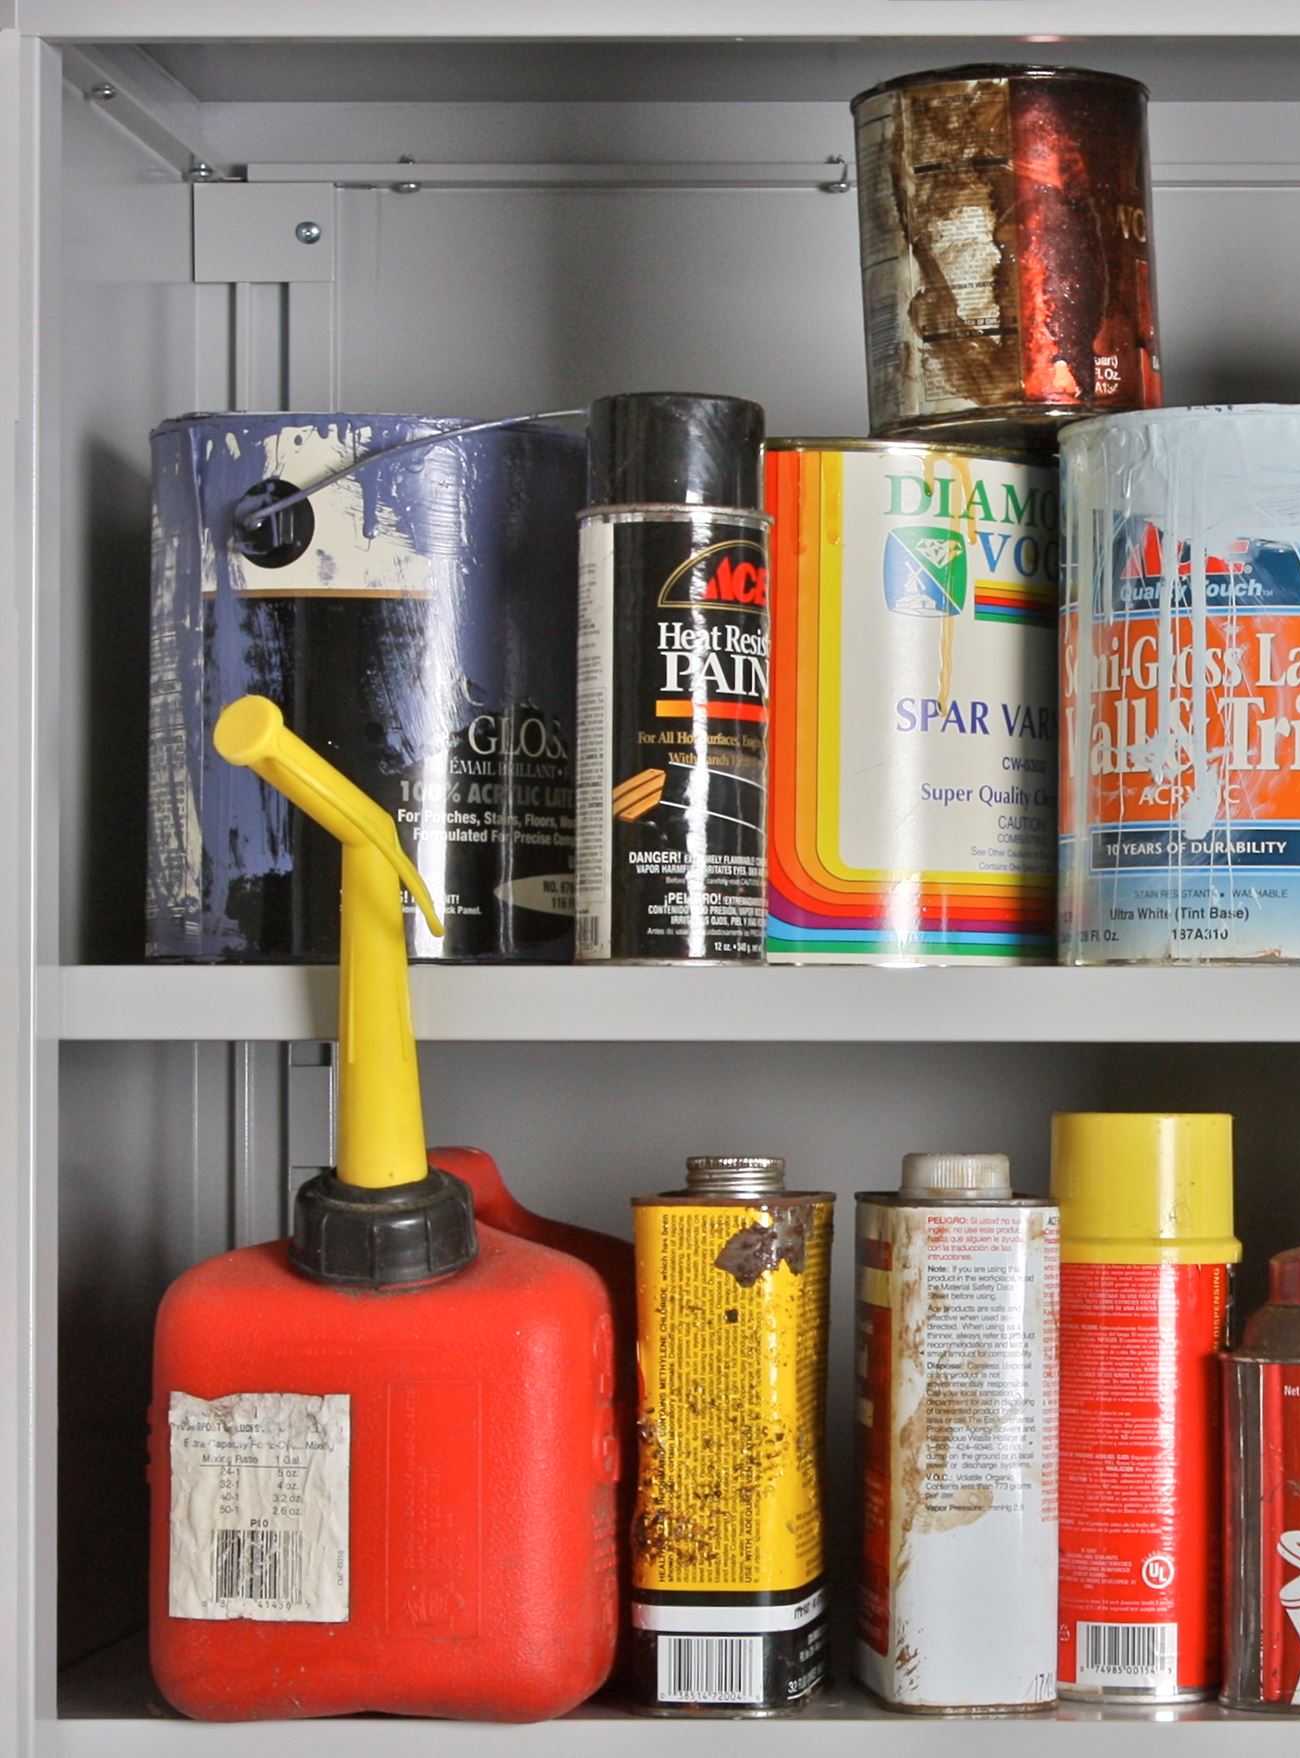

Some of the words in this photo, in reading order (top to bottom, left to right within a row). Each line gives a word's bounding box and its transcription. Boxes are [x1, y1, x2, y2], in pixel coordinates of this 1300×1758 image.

[657, 621, 722, 651] Heat
[895, 697, 991, 736] SPAR
[449, 755, 496, 776] ÉMAIL
[920, 782, 972, 806] Super
[979, 784, 1031, 811] Quality
[397, 808, 419, 823] For
[513, 830, 551, 845] Precise
[1122, 841, 1162, 855] YEARS
[1166, 840, 1187, 855] OF
[1191, 839, 1286, 855] DURABILITY
[628, 850, 682, 863] DANGER!
[1231, 888, 1288, 899] WASHABLE
[1109, 907, 1134, 921] Ultra
[1137, 907, 1170, 920] White
[1174, 906, 1206, 923] (Tint
[1209, 906, 1249, 921] Base)
[1283, 1385, 1299, 1396] Net
